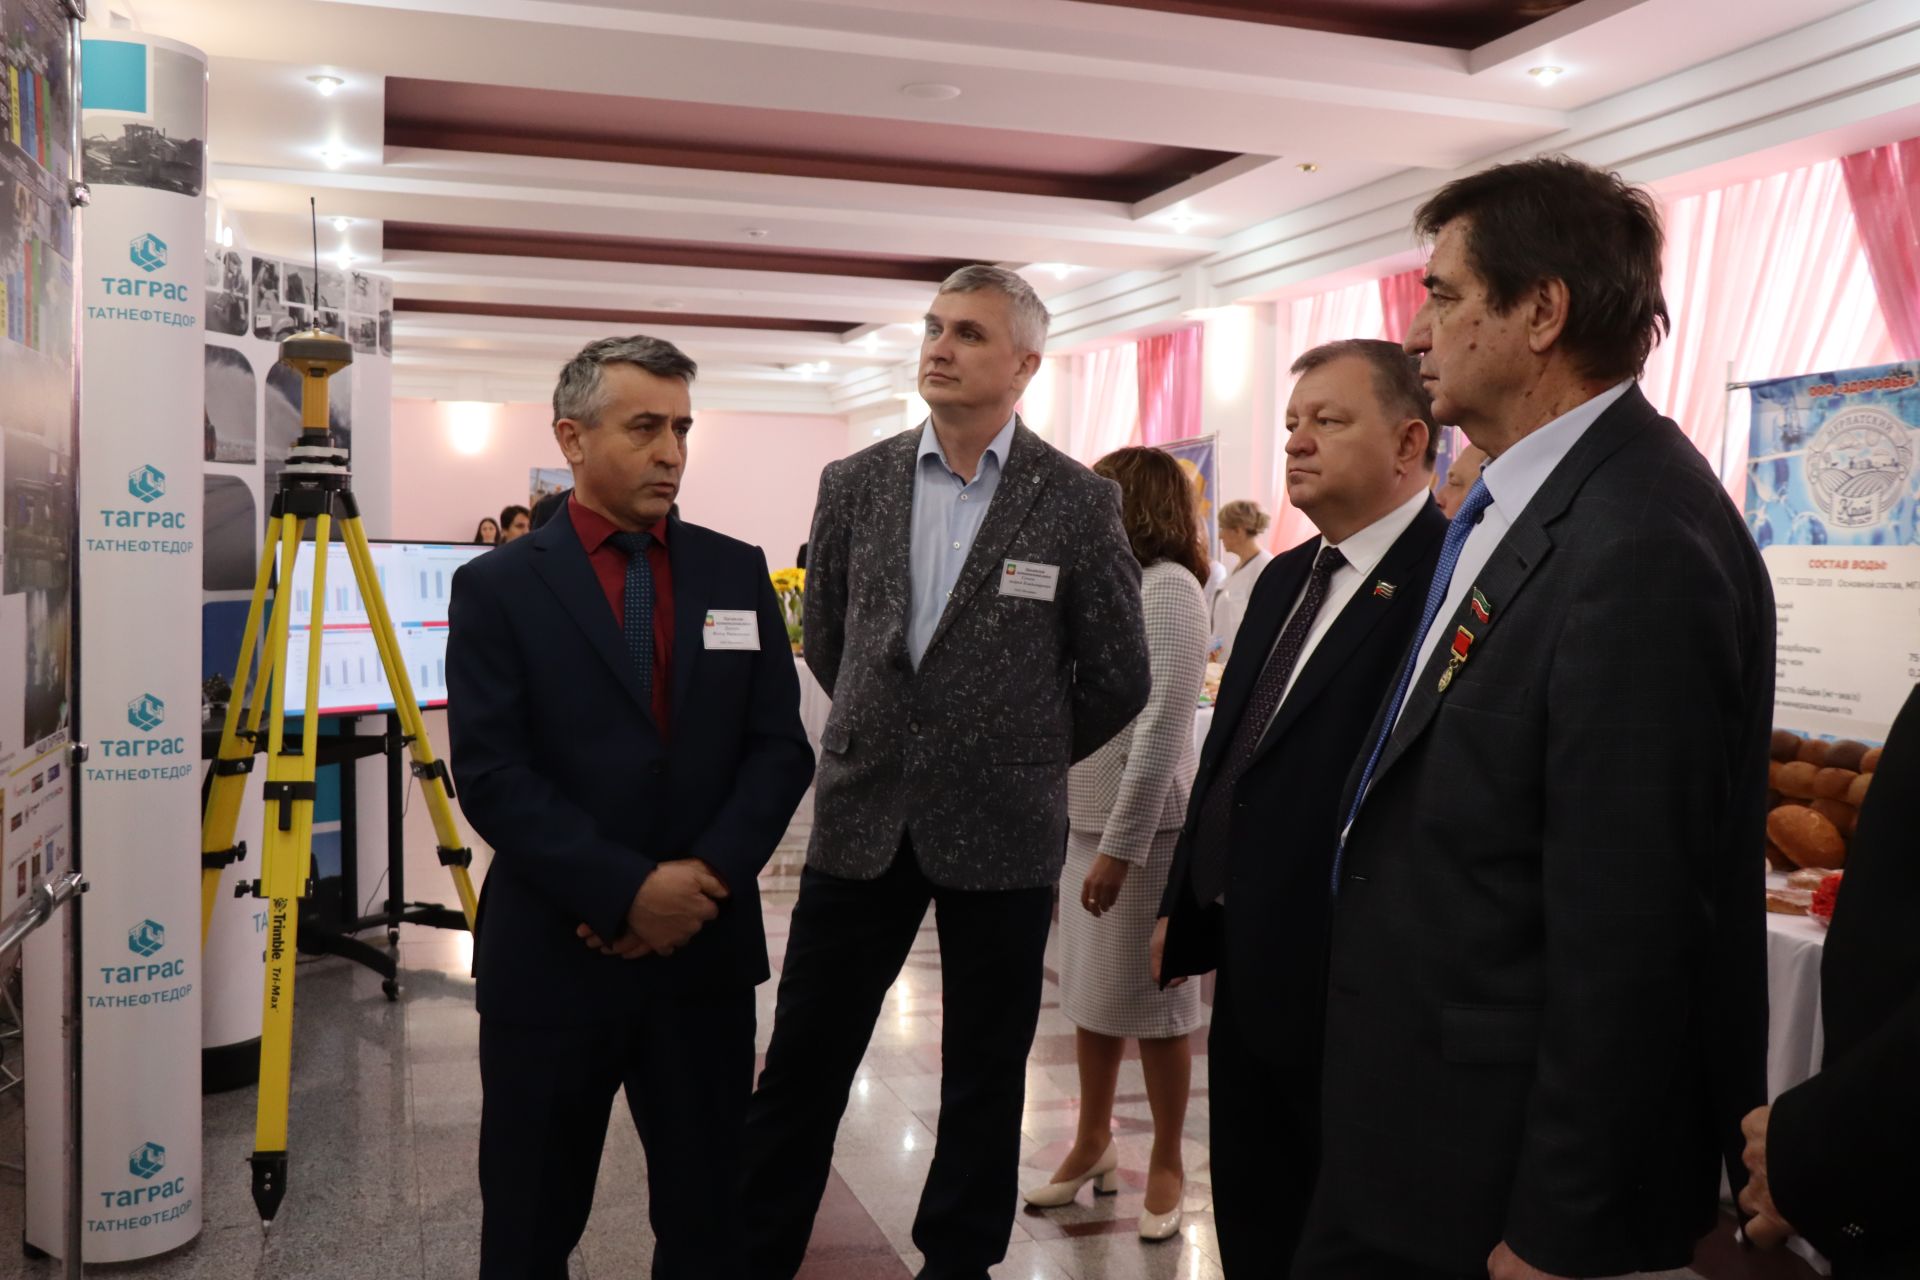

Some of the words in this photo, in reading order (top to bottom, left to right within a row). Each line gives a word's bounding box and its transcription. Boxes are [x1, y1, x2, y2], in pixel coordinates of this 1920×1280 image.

[87, 306, 196, 327] ТАТНЕФТЕДОР
[1808, 384, 1834, 398] ООО
[86, 539, 193, 554] ТАТНЕФТЕДОР
[1808, 559, 1849, 569] СОСТАВ
[86, 764, 193, 780] ТАТНЕФТЕДОР
[272, 913, 286, 960] Trimble
[87, 983, 193, 1008] ТАТНЕФТЕДОР
[271, 967, 282, 1009] Tri-Max
[87, 1199, 192, 1232] ТАТНЕФТЕДОР
